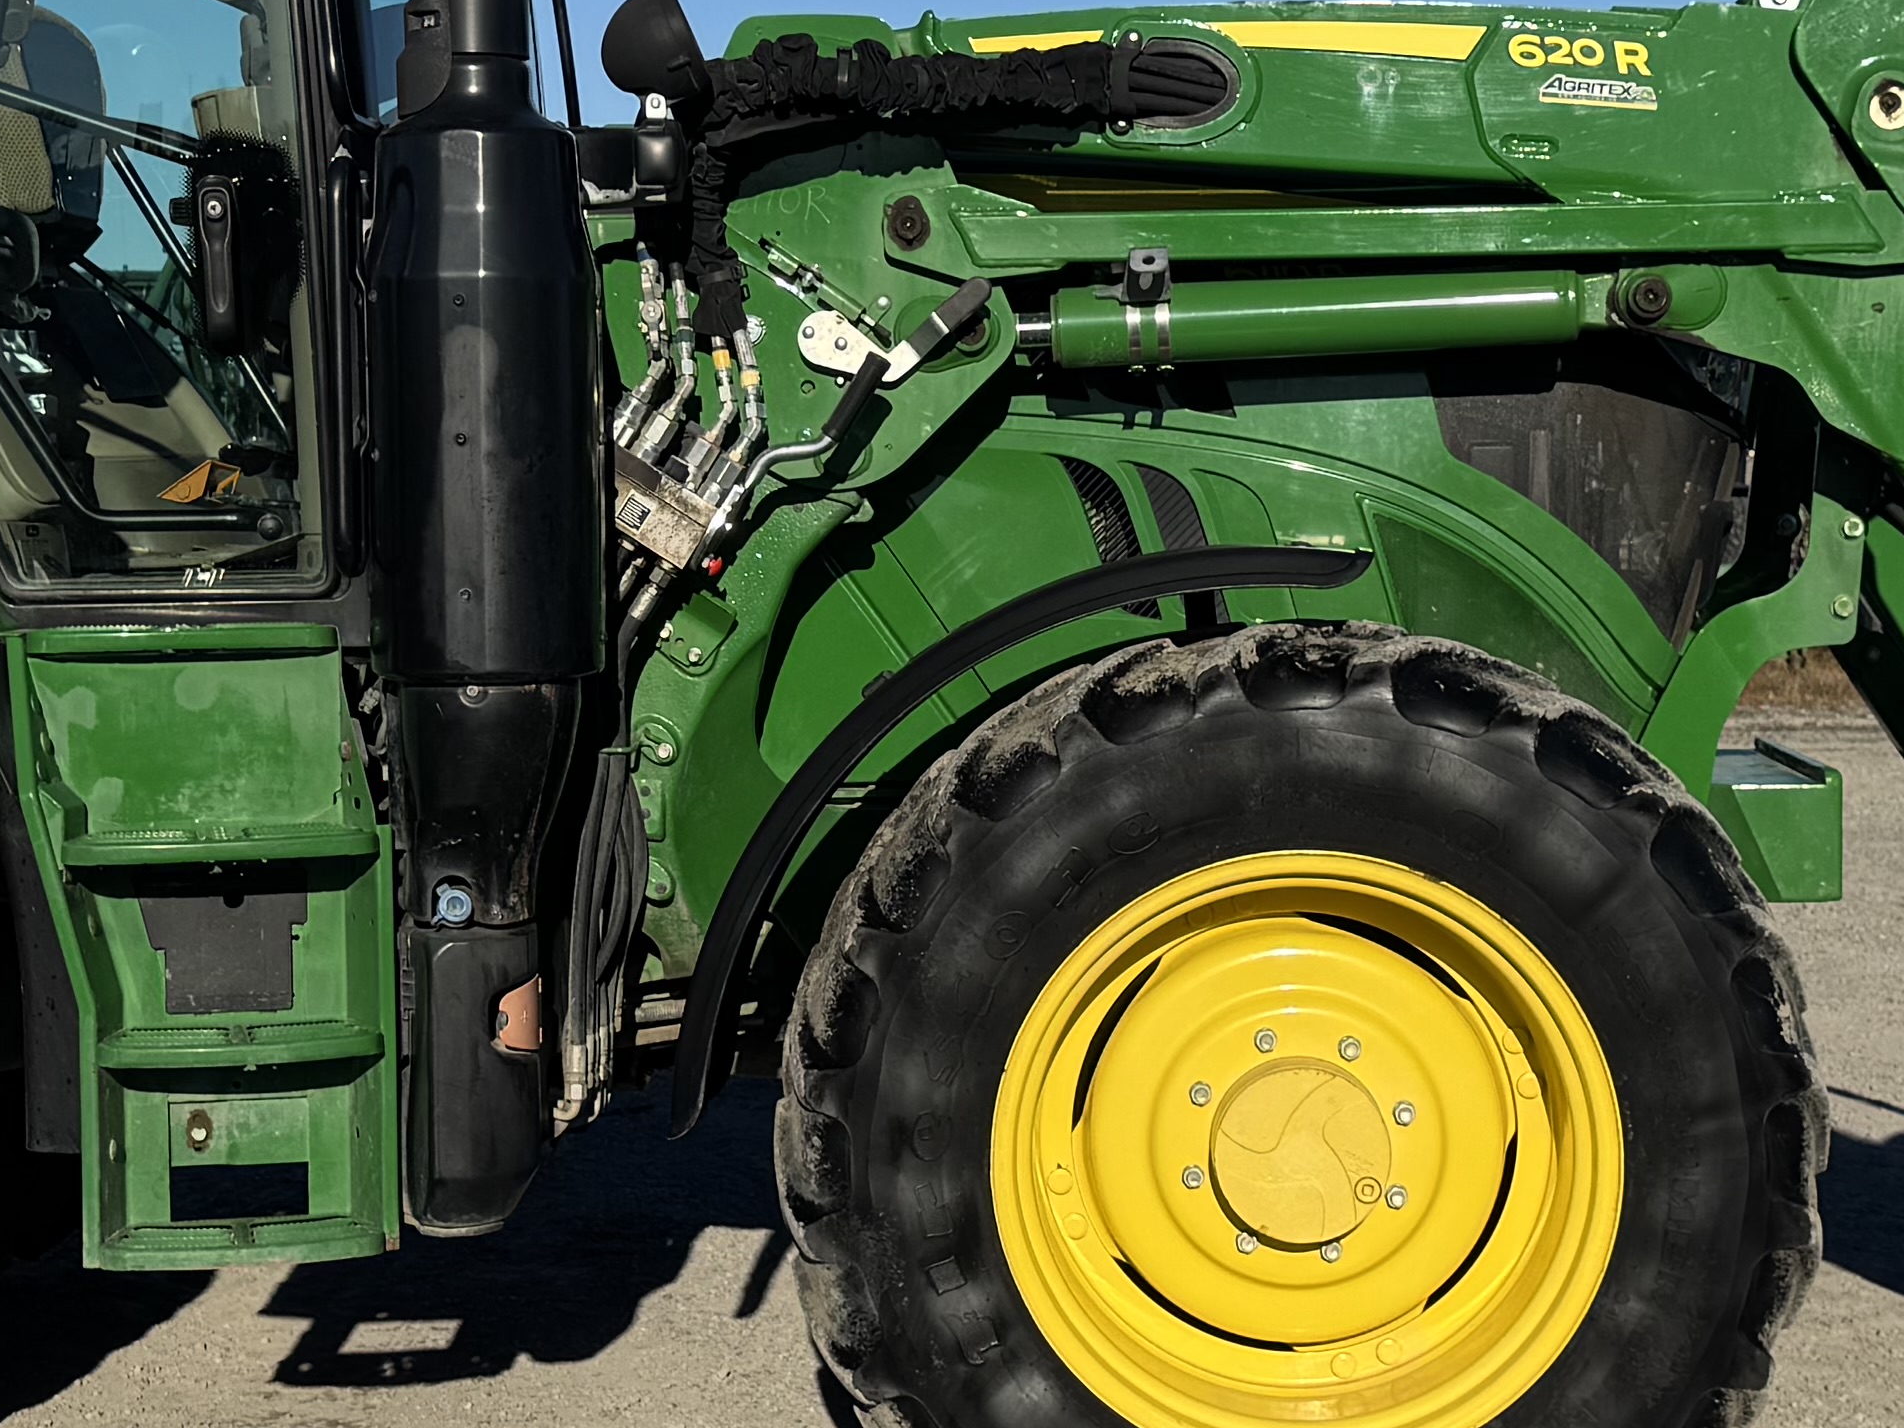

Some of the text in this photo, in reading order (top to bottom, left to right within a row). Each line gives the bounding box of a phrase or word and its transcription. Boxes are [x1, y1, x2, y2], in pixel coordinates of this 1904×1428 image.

[1508, 33, 1652, 76] 620 R
[1543, 76, 1634, 97] AGRITEX
